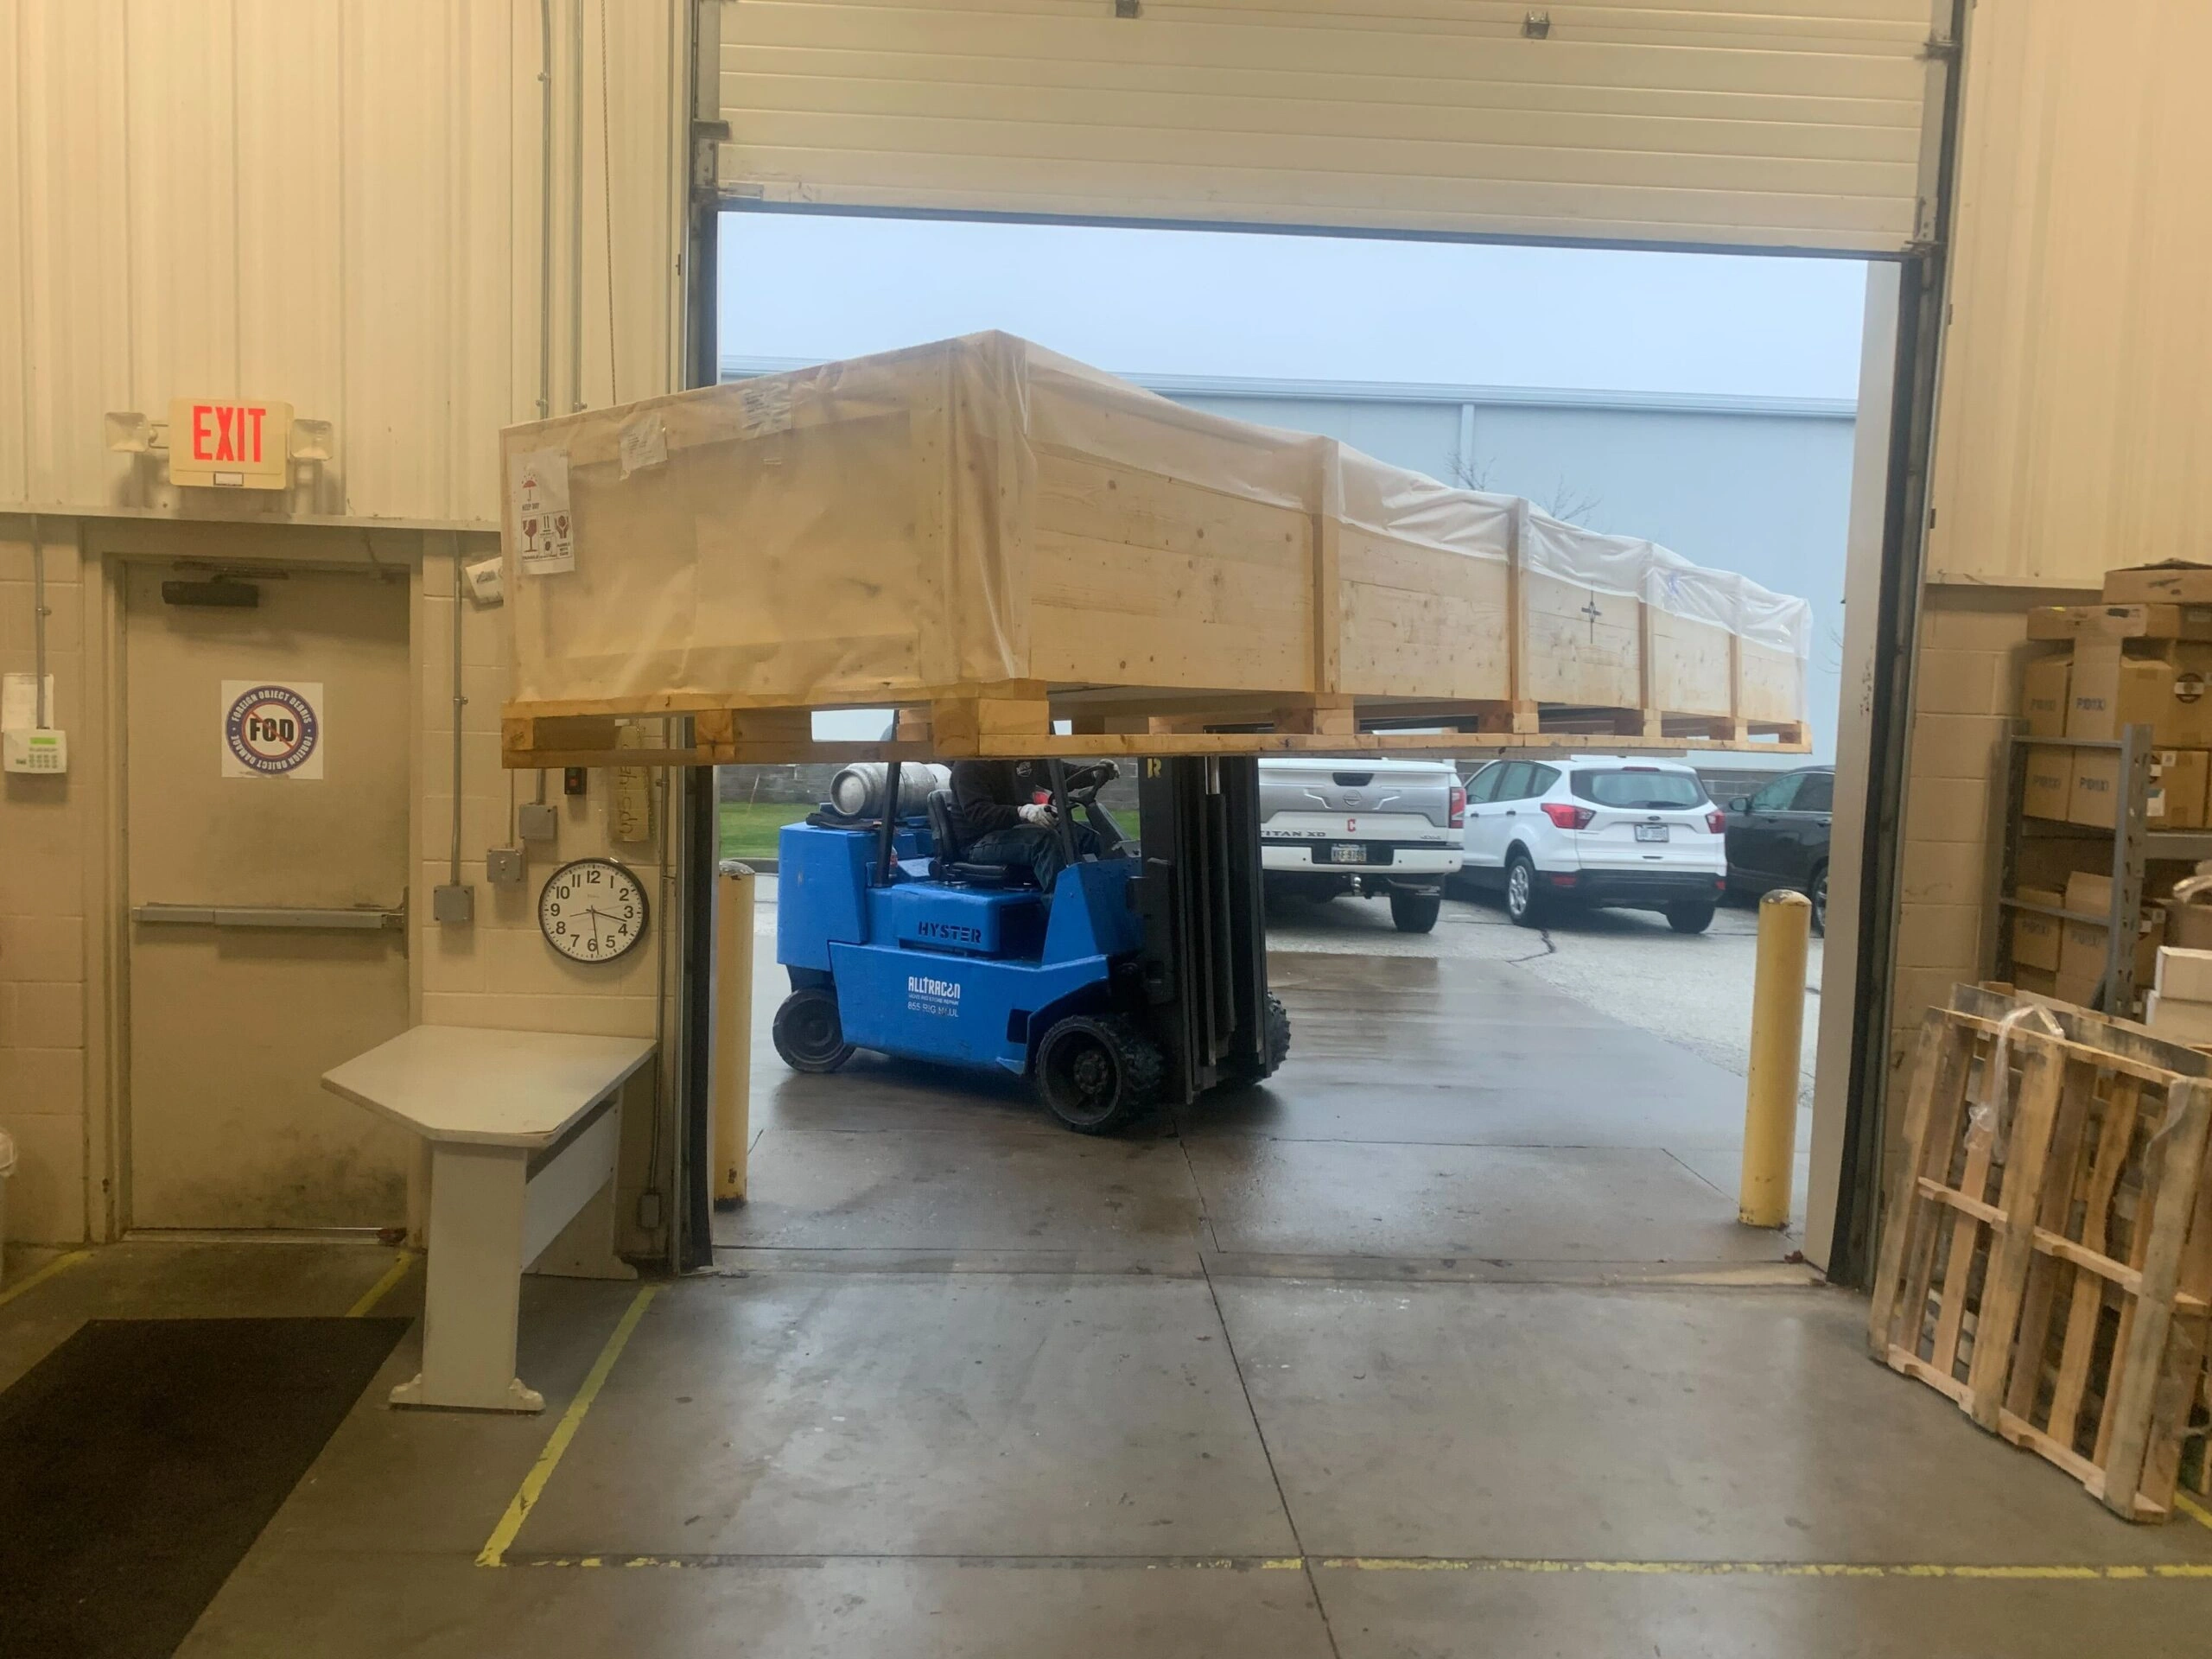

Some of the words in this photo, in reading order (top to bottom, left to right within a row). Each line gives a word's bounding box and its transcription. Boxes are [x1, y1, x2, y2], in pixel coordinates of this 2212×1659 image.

[193, 404, 266, 462] EXIT
[232, 694, 257, 721] FOREIGN
[259, 690, 289, 700] OBJECT
[289, 697, 312, 723] DEBRIS
[250, 718, 295, 742] FOD
[231, 734, 255, 765] DAMAGE
[289, 736, 313, 766] FOREIGN
[257, 760, 289, 770] OBJECT
[571, 874, 581, 887] 11
[587, 870, 601, 884] 12
[609, 875, 614, 889] 1
[556, 886, 570, 899] 10
[619, 887, 630, 901] 2
[550, 903, 561, 917] 9
[623, 906, 634, 918] 3
[556, 921, 566, 935] 8
[618, 923, 628, 937] 4
[918, 921, 982, 944] HYSTER
[570, 934, 580, 948] 7
[587, 938, 598, 952] 6
[605, 935, 616, 949] 5
[907, 1001, 921, 1011] 855
